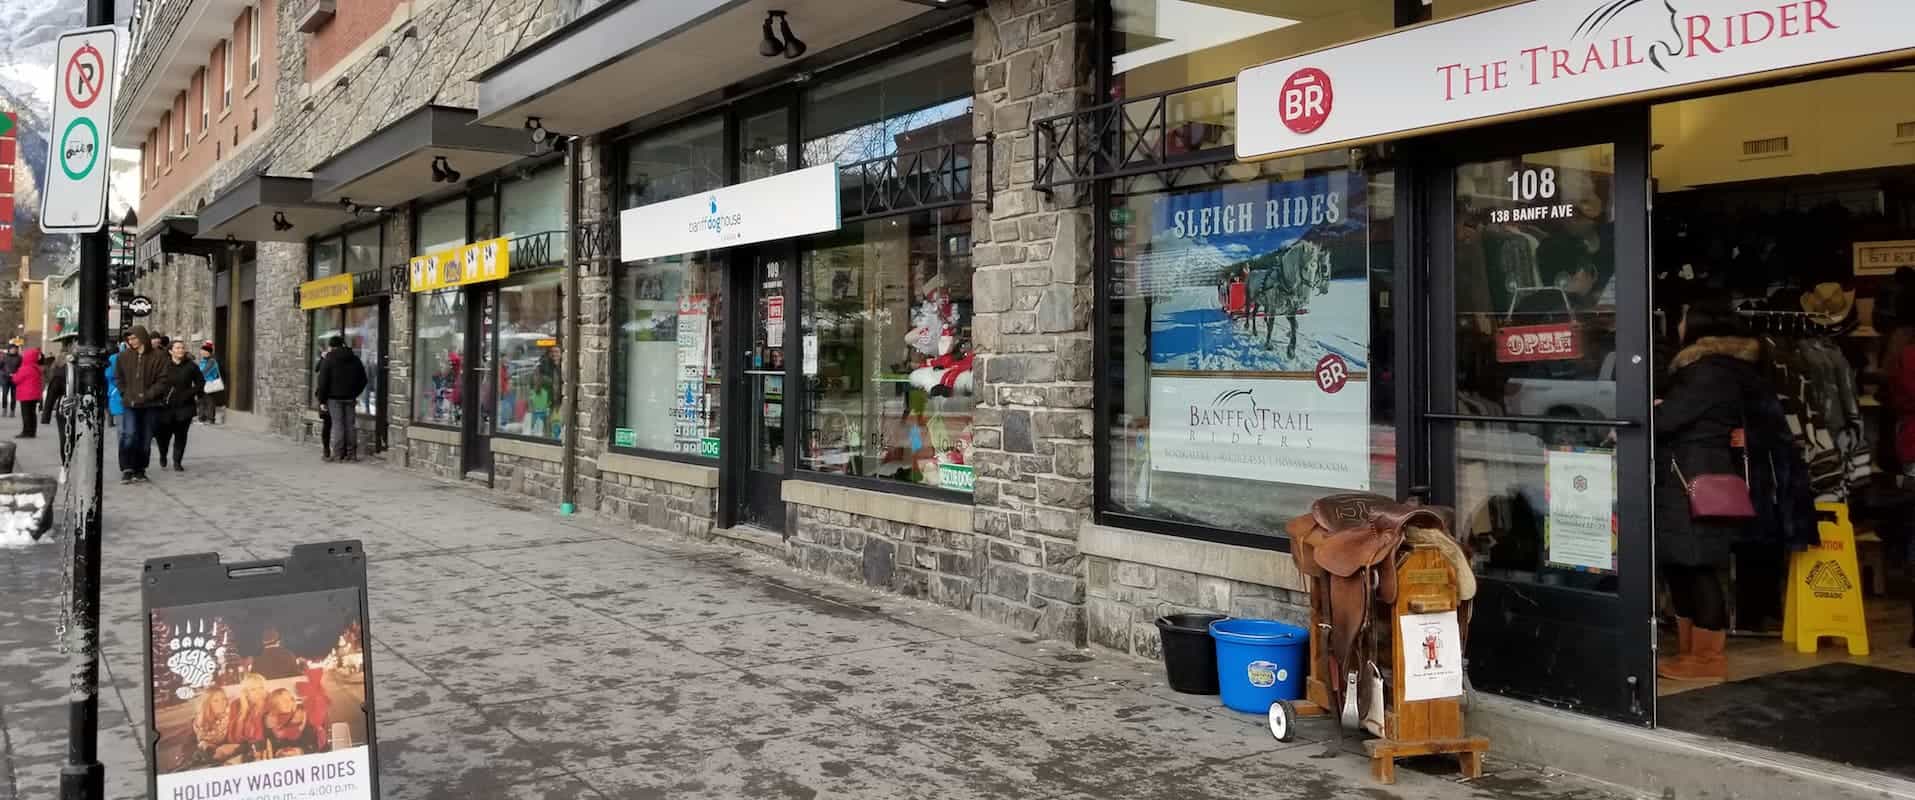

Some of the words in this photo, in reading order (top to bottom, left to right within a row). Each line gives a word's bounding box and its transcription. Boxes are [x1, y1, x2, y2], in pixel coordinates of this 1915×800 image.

[1437, 60, 1508, 101] THE
[1520, 35, 1644, 86] TRAIL
[1683, 0, 1840, 58] RIDER
[78, 63, 94, 95] P
[1286, 75, 1324, 120] BR
[1507, 168, 1555, 200] 108
[1174, 202, 1254, 239] SLEIGH
[1265, 191, 1340, 229] RIDES
[1490, 210, 1510, 223] 138
[1512, 206, 1548, 221] BANFF
[1551, 204, 1573, 218] AVE
[767, 262, 779, 278] 109
[1506, 331, 1572, 355] OPEN
[1319, 358, 1346, 389] BR
[1190, 405, 1244, 427] BANFF
[1255, 408, 1312, 431] TRAIL
[703, 441, 718, 454] DOG
[1190, 430, 1312, 448] RIDERS
[173, 777, 242, 800] HOLIDAY
[247, 767, 305, 791] WAGON
[311, 760, 356, 781] RIDES
